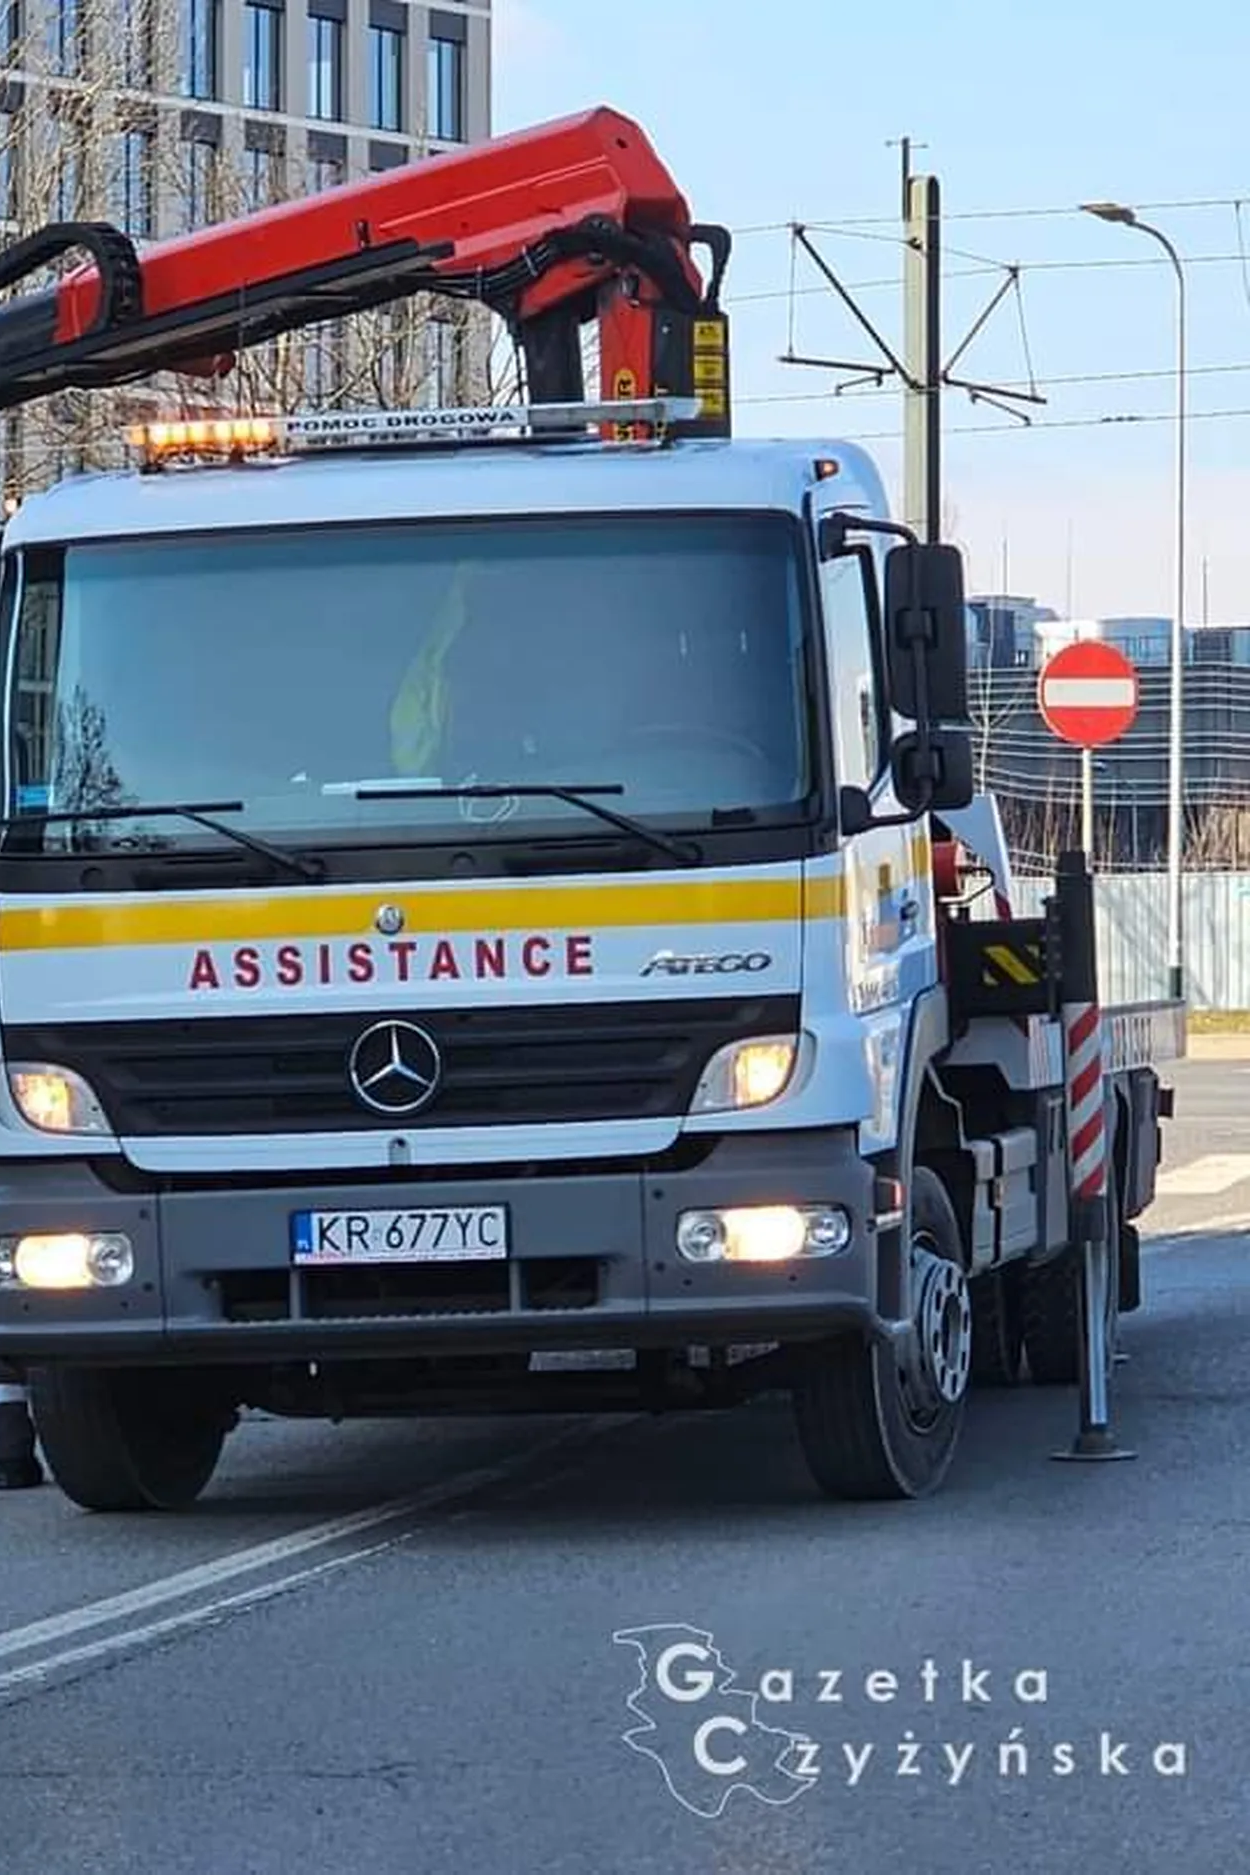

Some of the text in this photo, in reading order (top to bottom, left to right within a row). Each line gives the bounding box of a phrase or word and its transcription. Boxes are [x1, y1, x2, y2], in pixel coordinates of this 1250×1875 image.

[286, 410, 515, 433] POMOC DROGOWA
[189, 935, 594, 991] ASSISTANCE
[317, 1211, 499, 1252] KR 677YC
